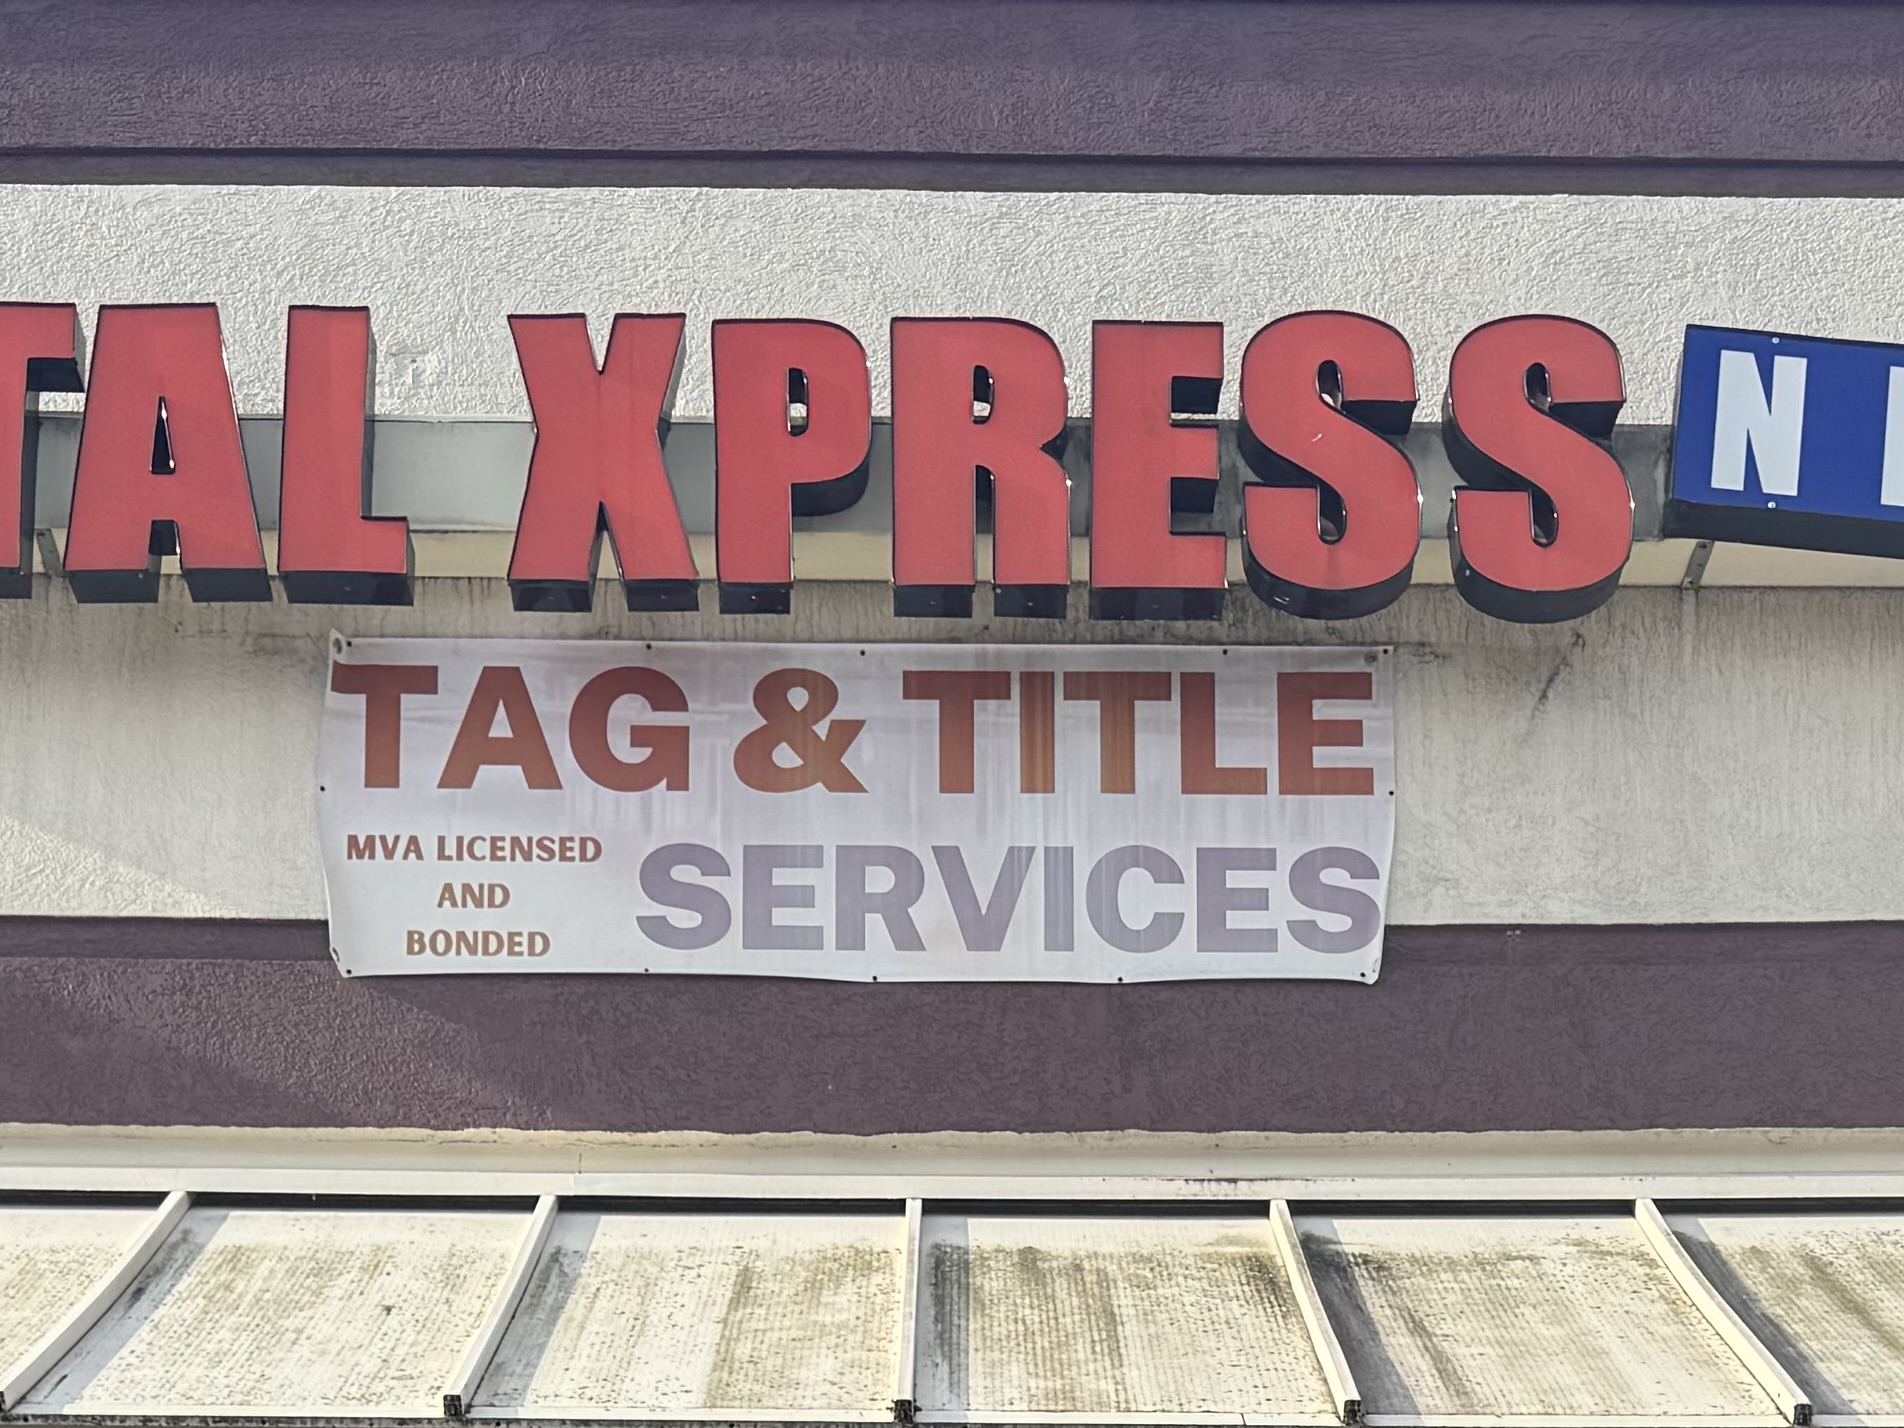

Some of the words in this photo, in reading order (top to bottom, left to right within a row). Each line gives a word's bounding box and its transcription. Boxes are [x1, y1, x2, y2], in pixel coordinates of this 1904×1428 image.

[507, 310, 1634, 594] XPRESS
[1710, 350, 1808, 497] N
[330, 664, 691, 792] TAG
[733, 667, 868, 793] &
[902, 670, 1374, 795] TITLE
[345, 834, 423, 862] MVA
[436, 834, 603, 864] LICENSED
[436, 882, 512, 910] AND
[634, 843, 1382, 953] SERVICES
[405, 928, 551, 958] BONDED
